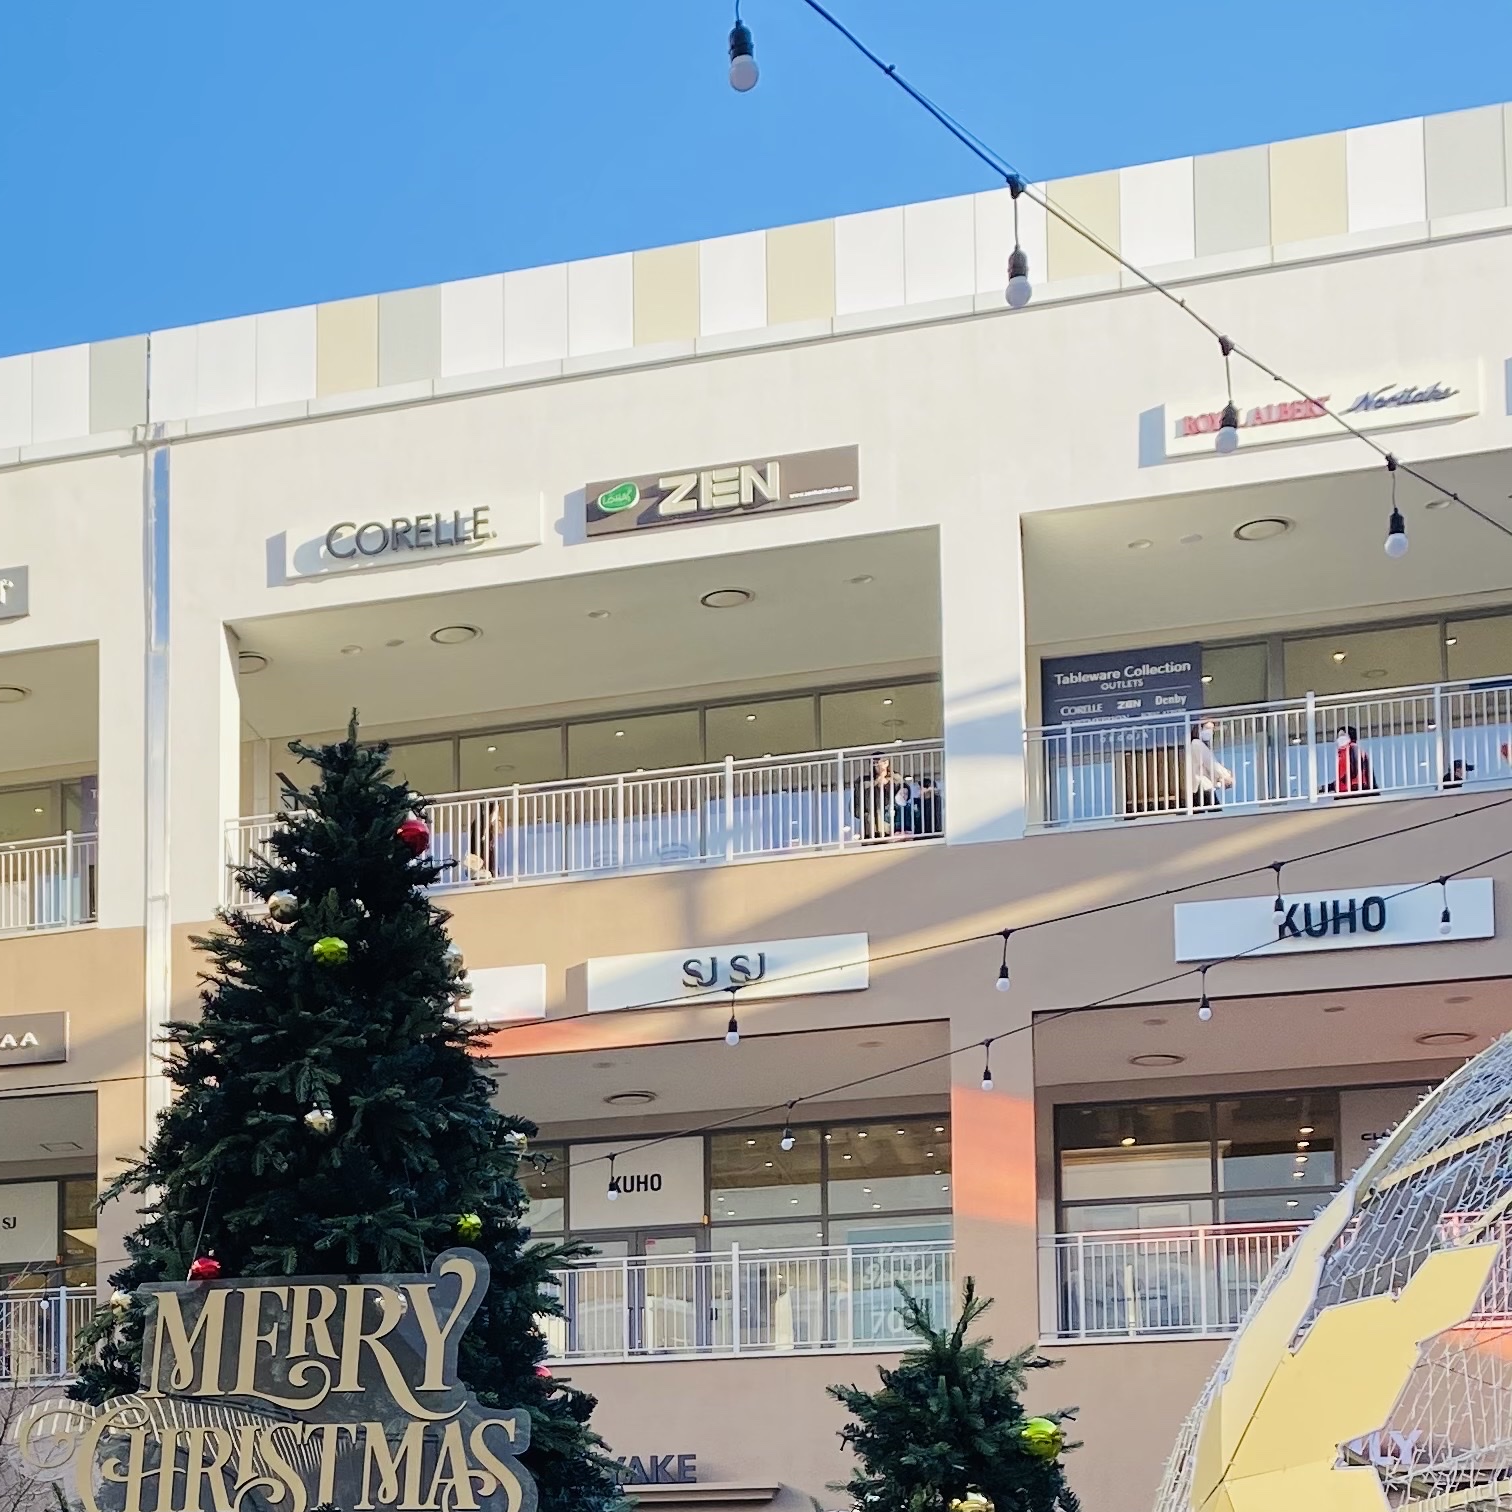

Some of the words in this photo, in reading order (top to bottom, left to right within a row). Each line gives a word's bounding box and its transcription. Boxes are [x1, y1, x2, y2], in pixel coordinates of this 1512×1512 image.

[1176, 407, 1246, 437] ROYL
[659, 461, 780, 516] ZEN
[1055, 670, 1121, 686] Tableware
[1124, 661, 1191, 678] Collection
[1100, 678, 1144, 691] OUTLETS
[1155, 694, 1187, 706] Denby
[1279, 896, 1387, 940] KUHO
[610, 1173, 662, 1193] KUHO
[139, 1258, 476, 1420] MERRY
